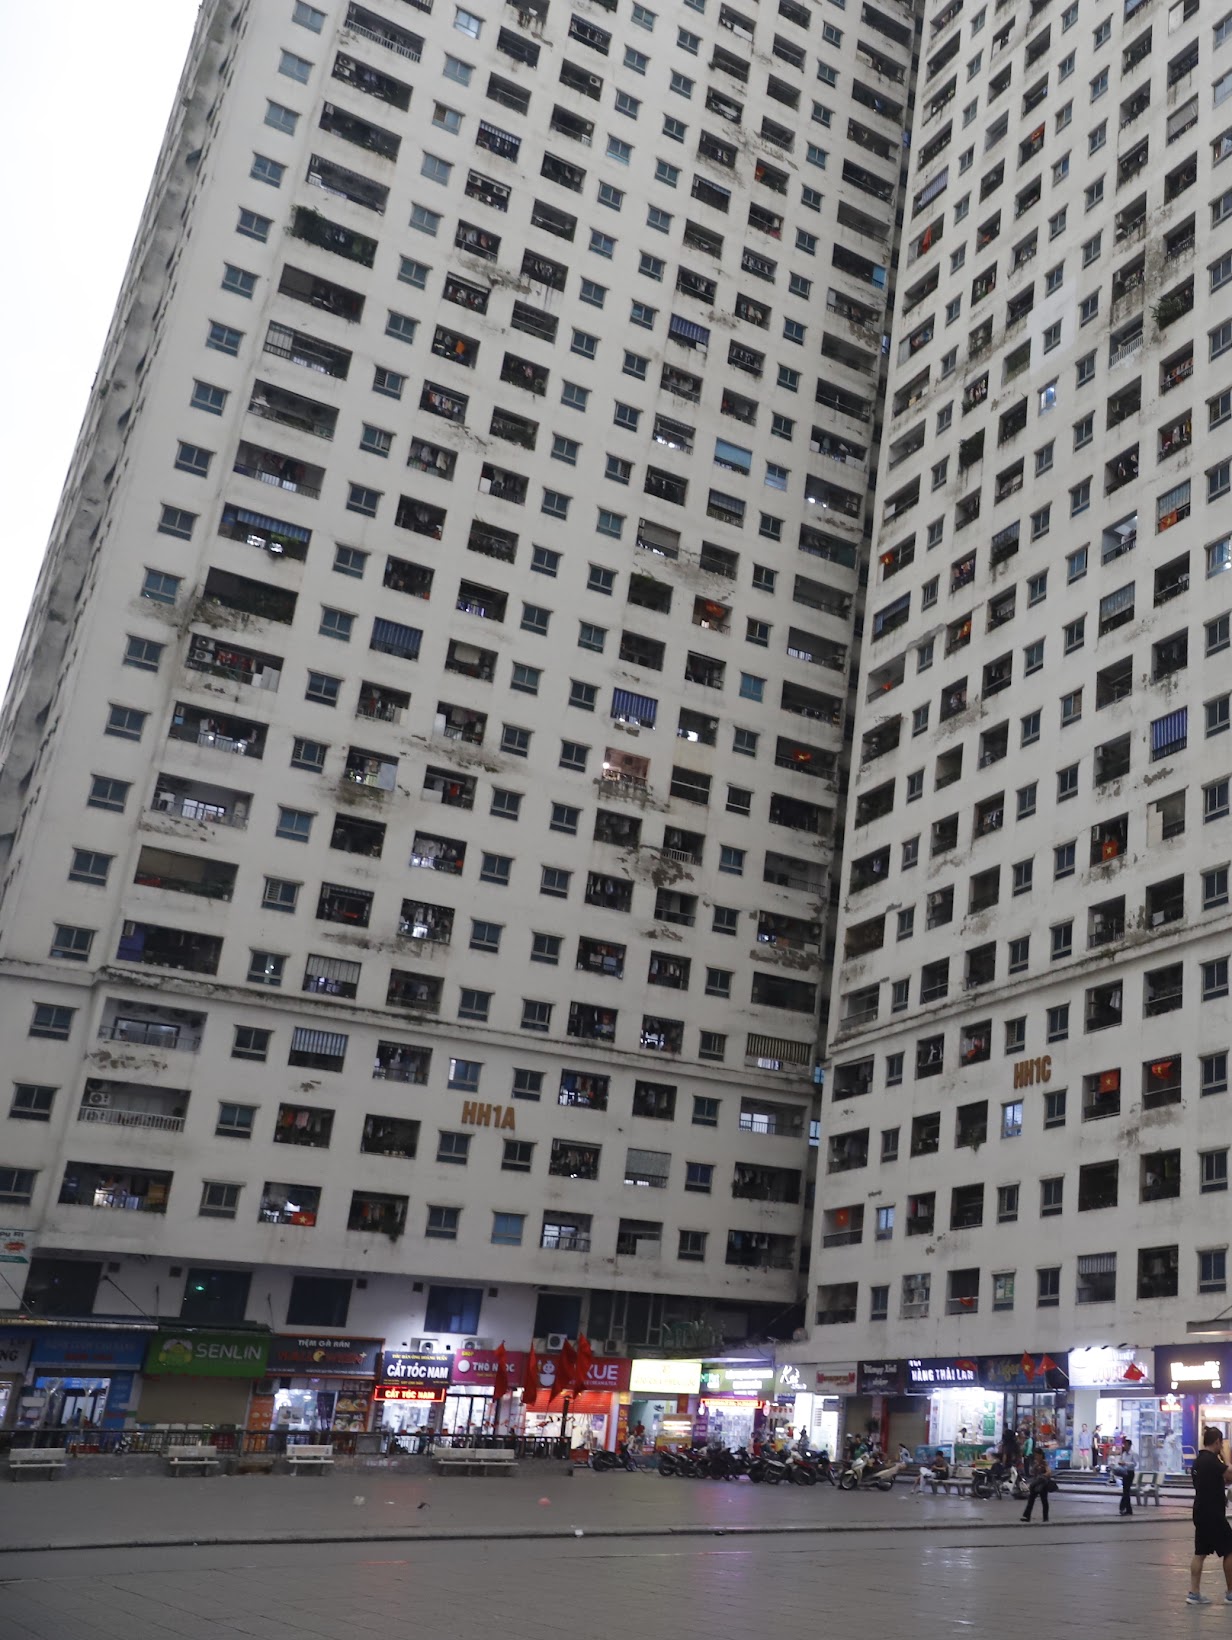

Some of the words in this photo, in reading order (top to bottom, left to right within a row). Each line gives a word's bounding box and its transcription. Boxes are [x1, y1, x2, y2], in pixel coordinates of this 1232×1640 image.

[1013, 1055, 1052, 1089] HH1C
[461, 1100, 515, 1130] HH1A
[195, 1342, 262, 1361] SENLIN
[407, 1361, 427, 1378] TÓC
[427, 1366, 449, 1379] NAM
[911, 1367, 935, 1382] HÀNG
[418, 1390, 435, 1399] NAM
